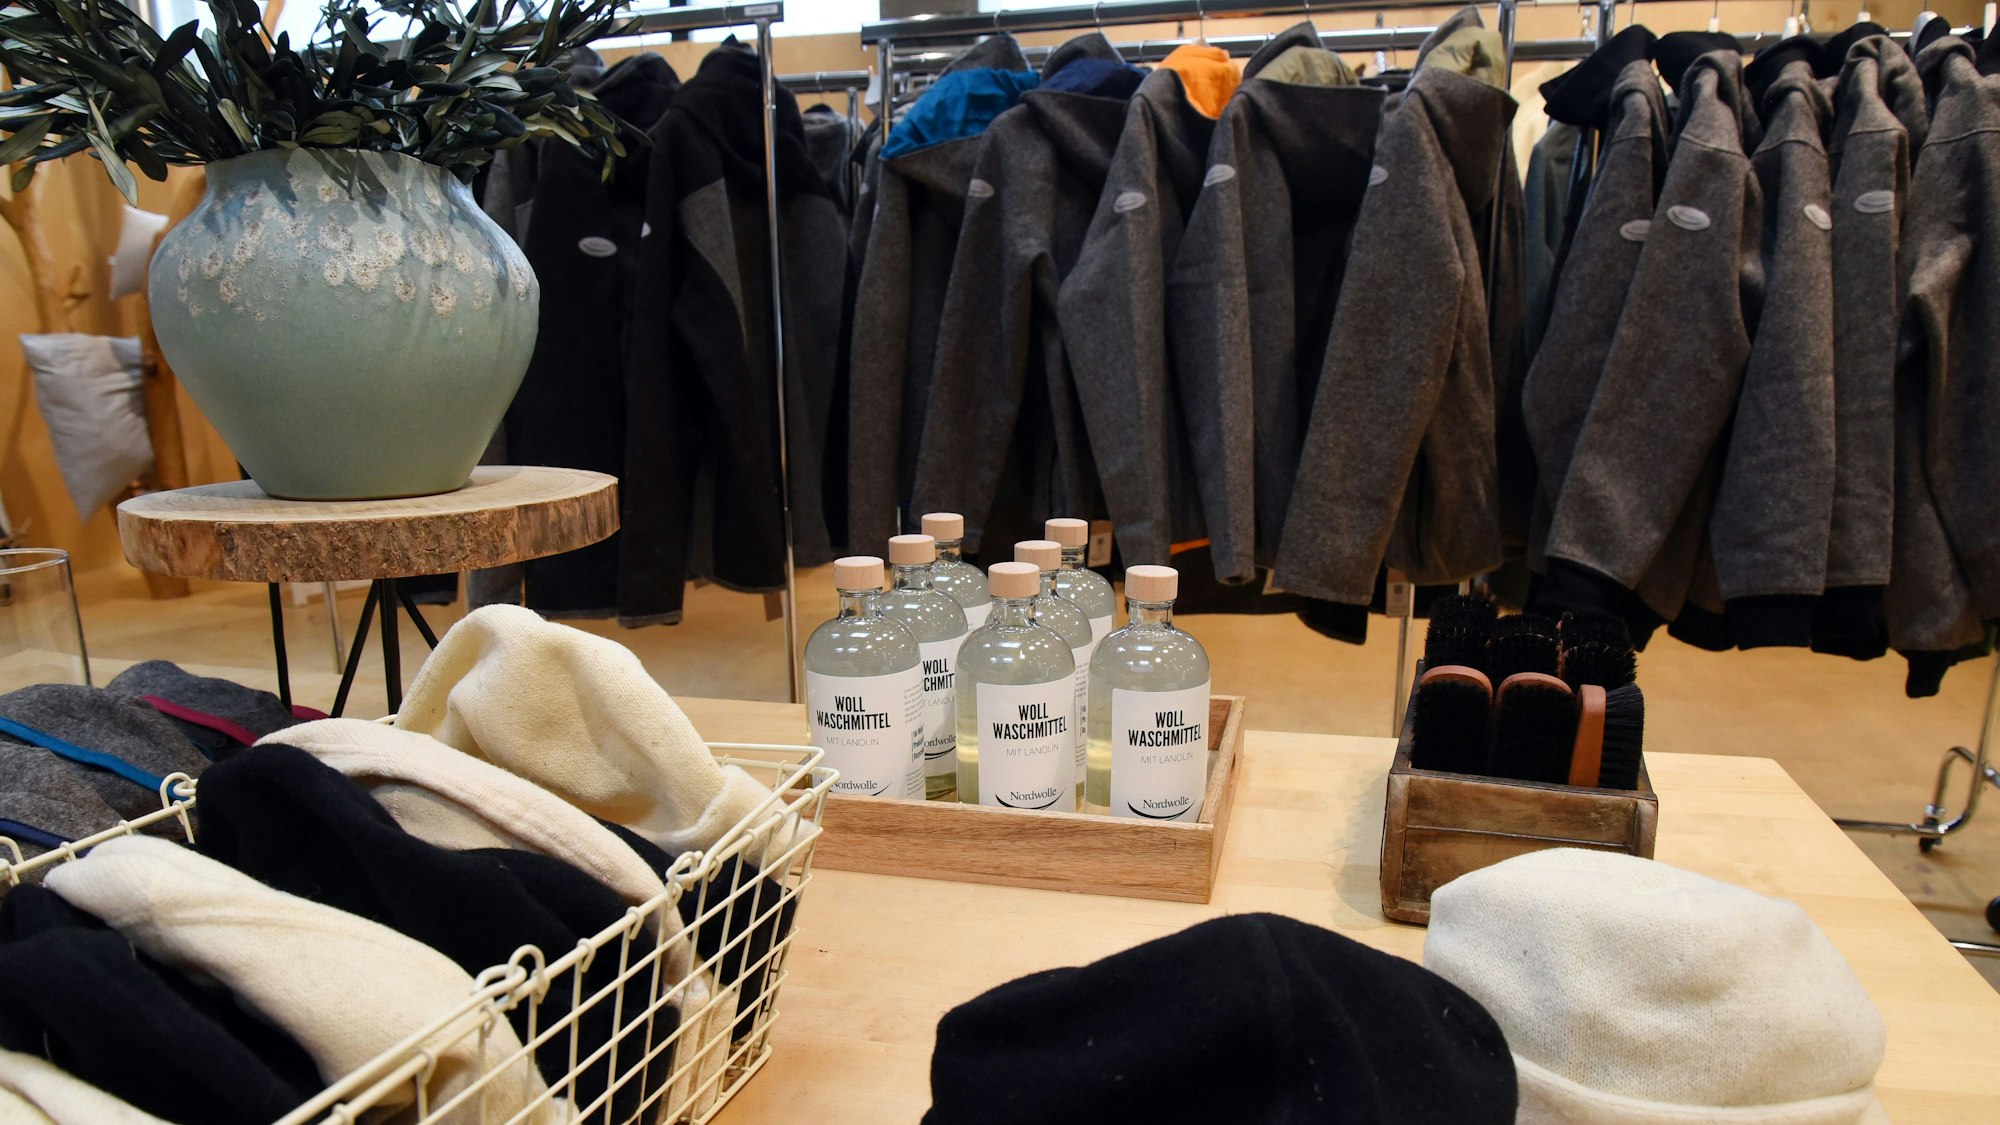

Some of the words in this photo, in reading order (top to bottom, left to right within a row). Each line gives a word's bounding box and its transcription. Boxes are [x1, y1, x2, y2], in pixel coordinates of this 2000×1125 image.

[923, 658, 949, 675] WOLL
[835, 695, 866, 713] WOLL
[1018, 702, 1049, 721] WOLL
[816, 710, 891, 730] WASCHMITTEL
[993, 715, 1067, 740] WASCHMITTEL
[1155, 710, 1185, 728] WOLL
[826, 736, 840, 744] MIT
[841, 738, 879, 746] LANOLIN
[924, 735, 956, 747] ordwolle
[1128, 723, 1202, 747] WASCHMITTEL
[1006, 748, 1022, 757] MIT
[1024, 743, 1059, 756] LANOLIN
[1140, 755, 1157, 764] MIT
[1159, 752, 1194, 764] LANOLIN
[1010, 787, 1057, 801] Nordwolle
[1142, 796, 1190, 809] Nordwolle
